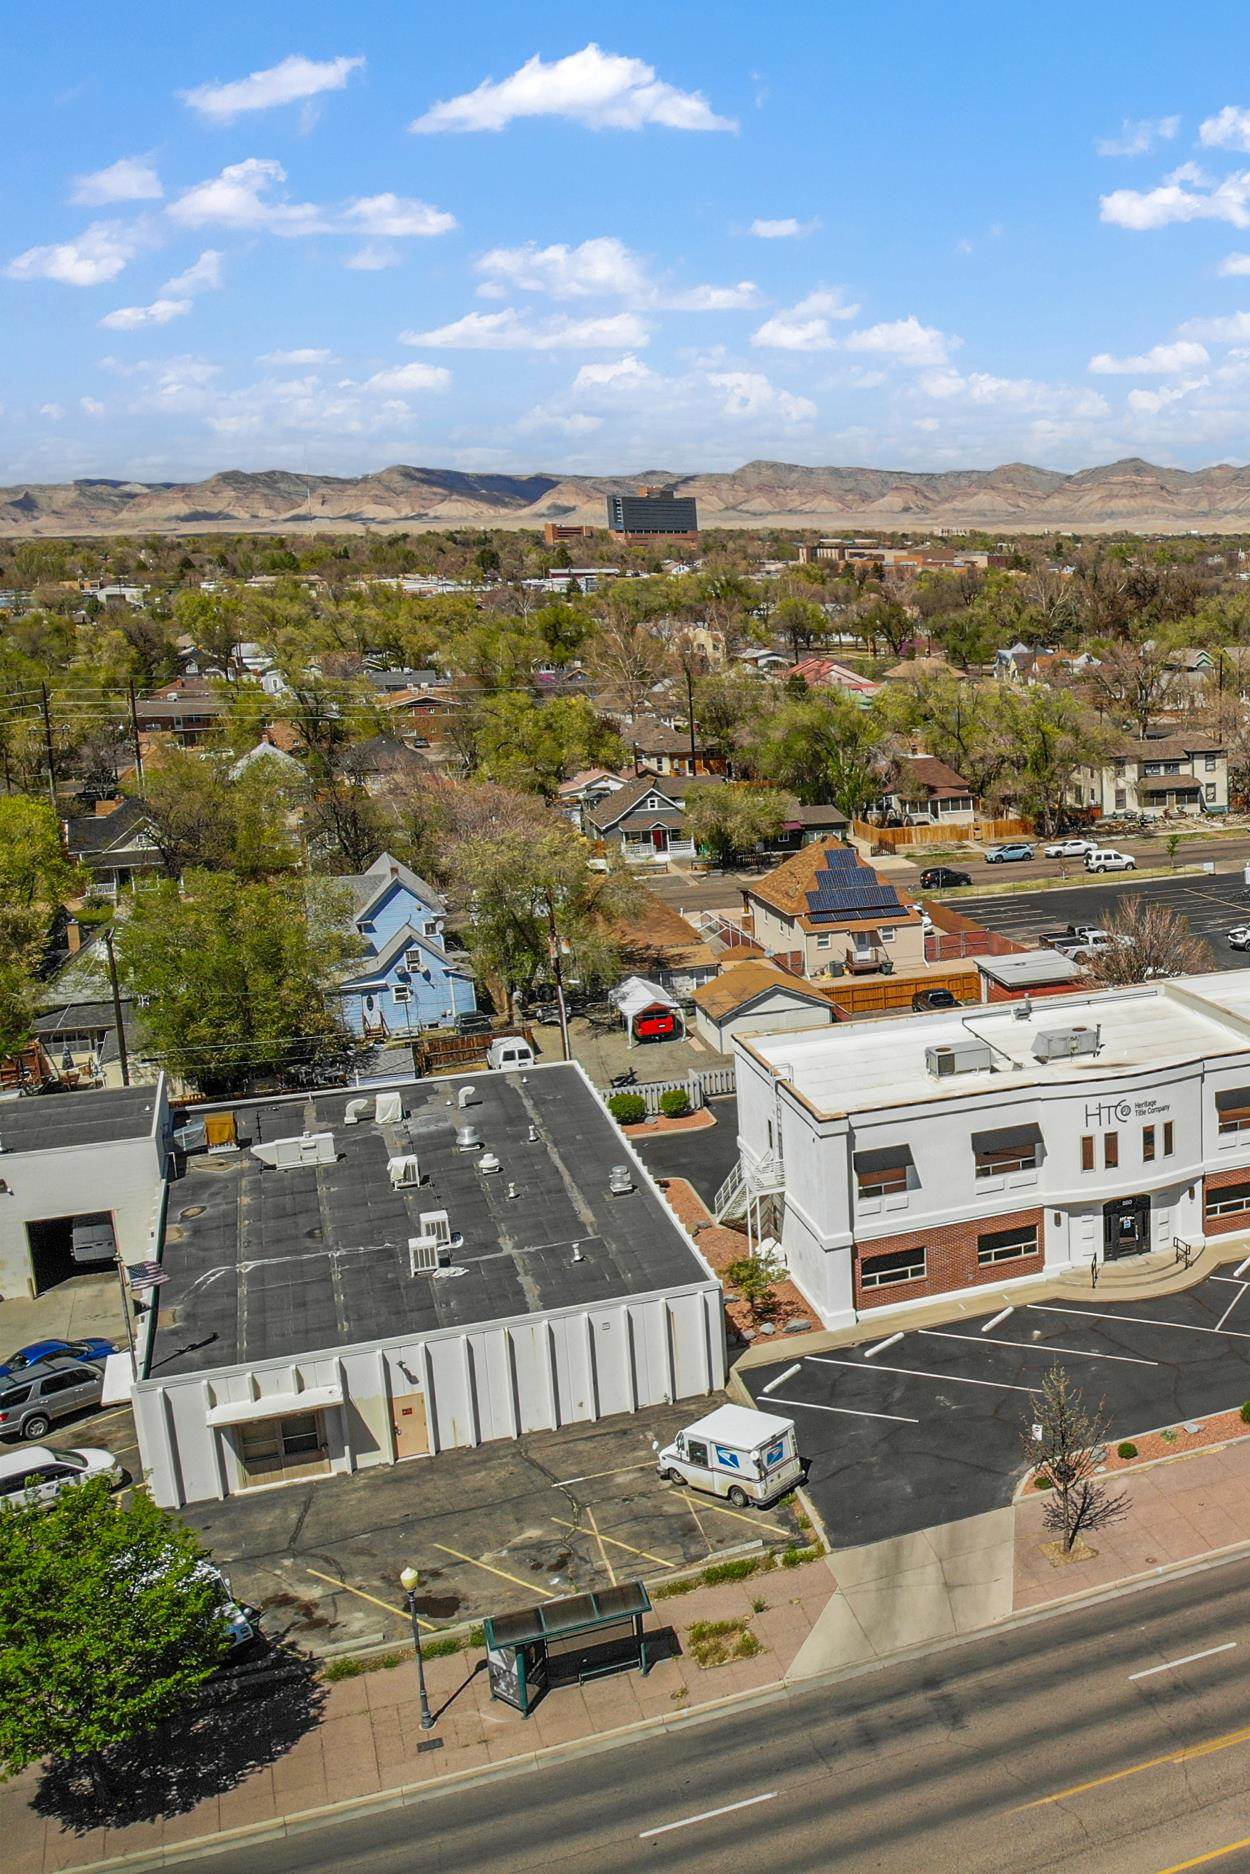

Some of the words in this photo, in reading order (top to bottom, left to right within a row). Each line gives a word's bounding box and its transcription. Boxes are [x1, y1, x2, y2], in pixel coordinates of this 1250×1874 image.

[1134, 1099, 1157, 1109] Heritage
[1135, 1107, 1147, 1117] Title
[1147, 1103, 1171, 1115] Company
